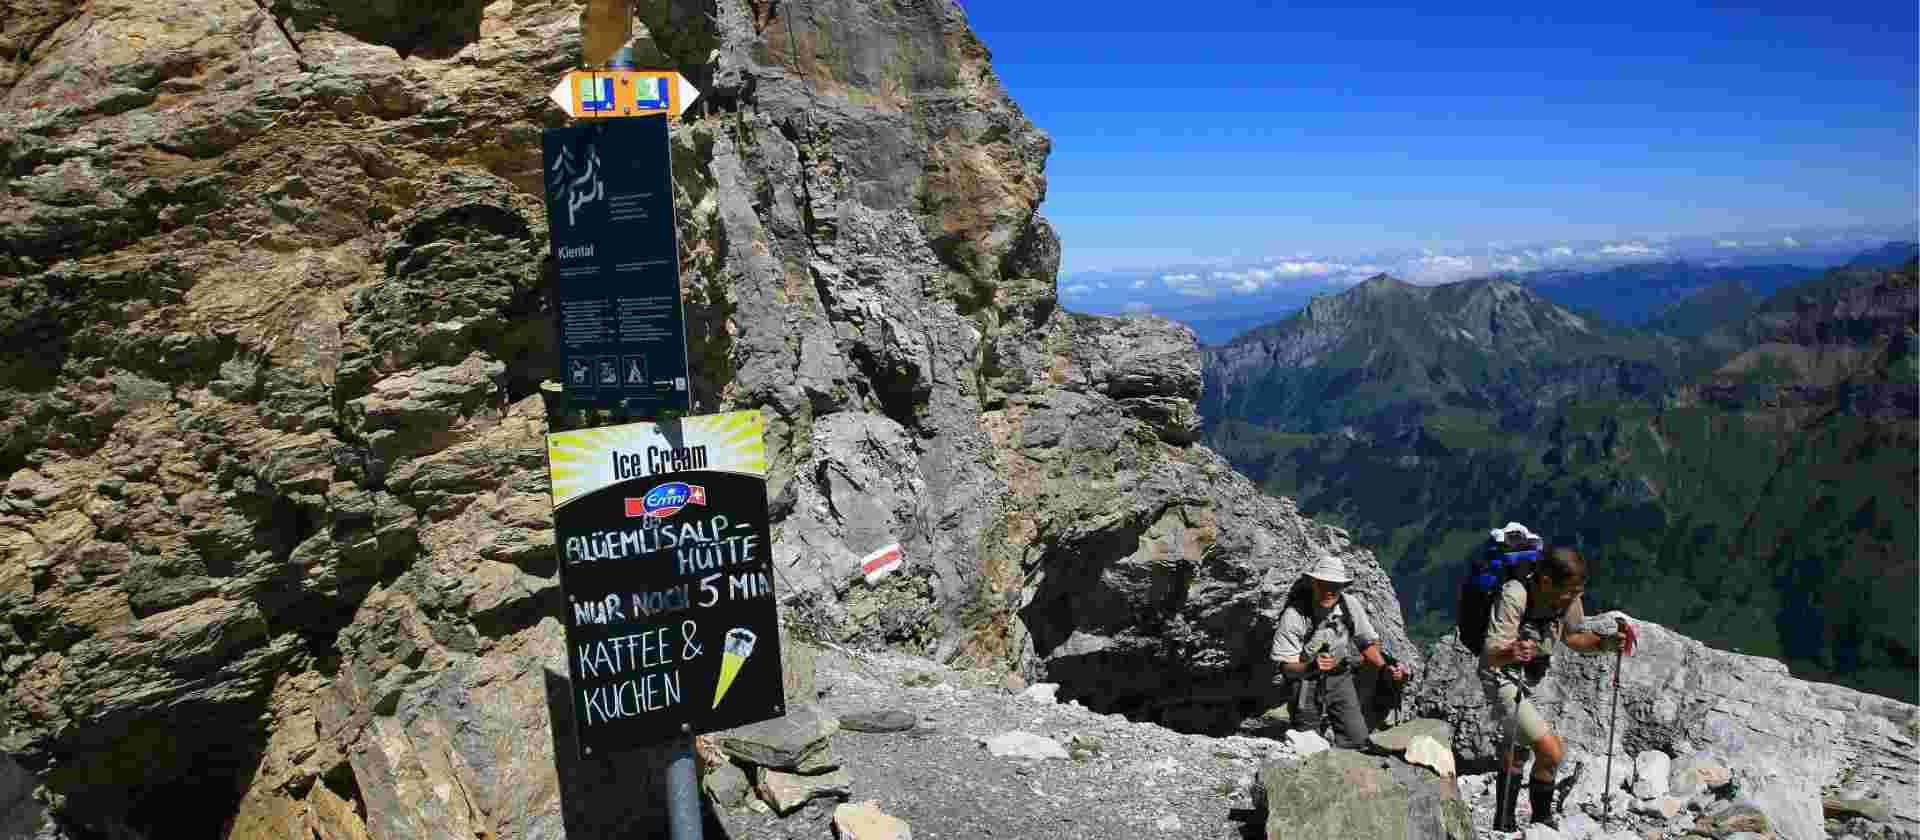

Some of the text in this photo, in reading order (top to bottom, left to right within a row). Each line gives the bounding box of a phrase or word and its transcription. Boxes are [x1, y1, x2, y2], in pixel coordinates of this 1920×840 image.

[558, 243, 595, 260] Kiental
[612, 444, 708, 480] Ice Cream
[678, 534, 759, 575] HÜTTE
[573, 592, 625, 626] NUR
[698, 573, 722, 608] 5
[578, 619, 704, 680] KAFFEE &
[583, 669, 681, 727] KUCHEN
